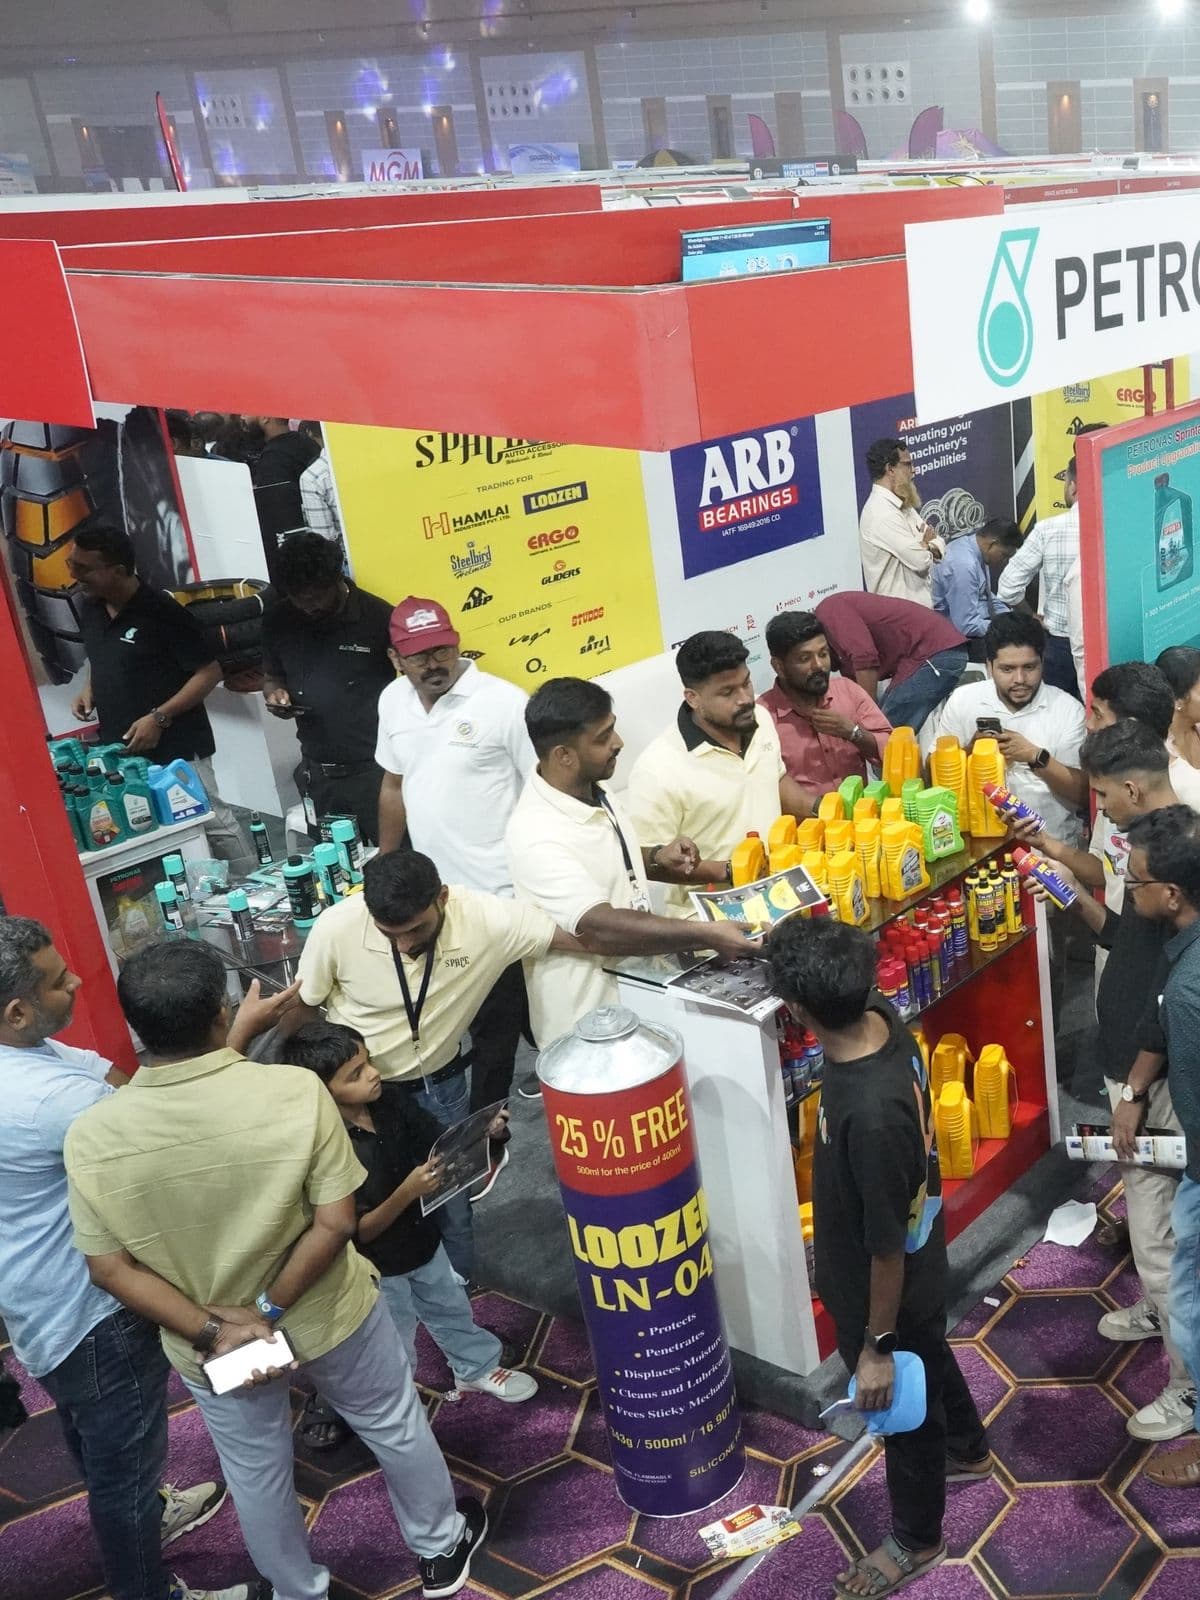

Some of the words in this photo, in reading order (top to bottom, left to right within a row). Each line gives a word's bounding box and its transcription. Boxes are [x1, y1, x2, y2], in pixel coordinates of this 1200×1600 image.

[370, 161, 419, 181] MGM
[950, 420, 972, 436] your
[504, 449, 525, 459] AUTO
[527, 442, 564, 454] ACCESSO
[1127, 433, 1173, 460] PETRONAS
[700, 429, 795, 507] ARB
[912, 452, 967, 475] apabilities
[476, 478, 515, 493] TRADING
[516, 474, 534, 484] FOR
[530, 486, 582, 510] LOOZEN
[703, 488, 793, 528] BEARINGS
[452, 504, 509, 527] HAMLAI
[527, 525, 579, 550] ERGO
[722, 527, 737, 537] IATF
[450, 545, 492, 570] Steelbird
[541, 567, 581, 585] GLIDERS
[498, 613, 517, 624] OUR
[518, 602, 553, 618] BRANDS
[445, 955, 470, 968] SPACE
[556, 1114, 589, 1158] 25
[592, 1119, 625, 1159] %
[630, 1086, 689, 1154] FREE
[576, 1165, 600, 1176] 500ml
[601, 1167, 613, 1176] for
[615, 1165, 629, 1175] the
[630, 1161, 652, 1176] price
[653, 1155, 661, 1166] of
[661, 1143, 682, 1162] 400ml
[590, 1241, 714, 1312] LN-04
[649, 1312, 697, 1336] Protects
[645, 1330, 705, 1358] Penetrates
[624, 1365, 680, 1381] Displaces
[619, 1387, 658, 1399] Cleans
[661, 1383, 684, 1397] and
[616, 1405, 645, 1419] Frees
[648, 1404, 686, 1419] Sticky
[645, 1434, 687, 1449] 500ml
